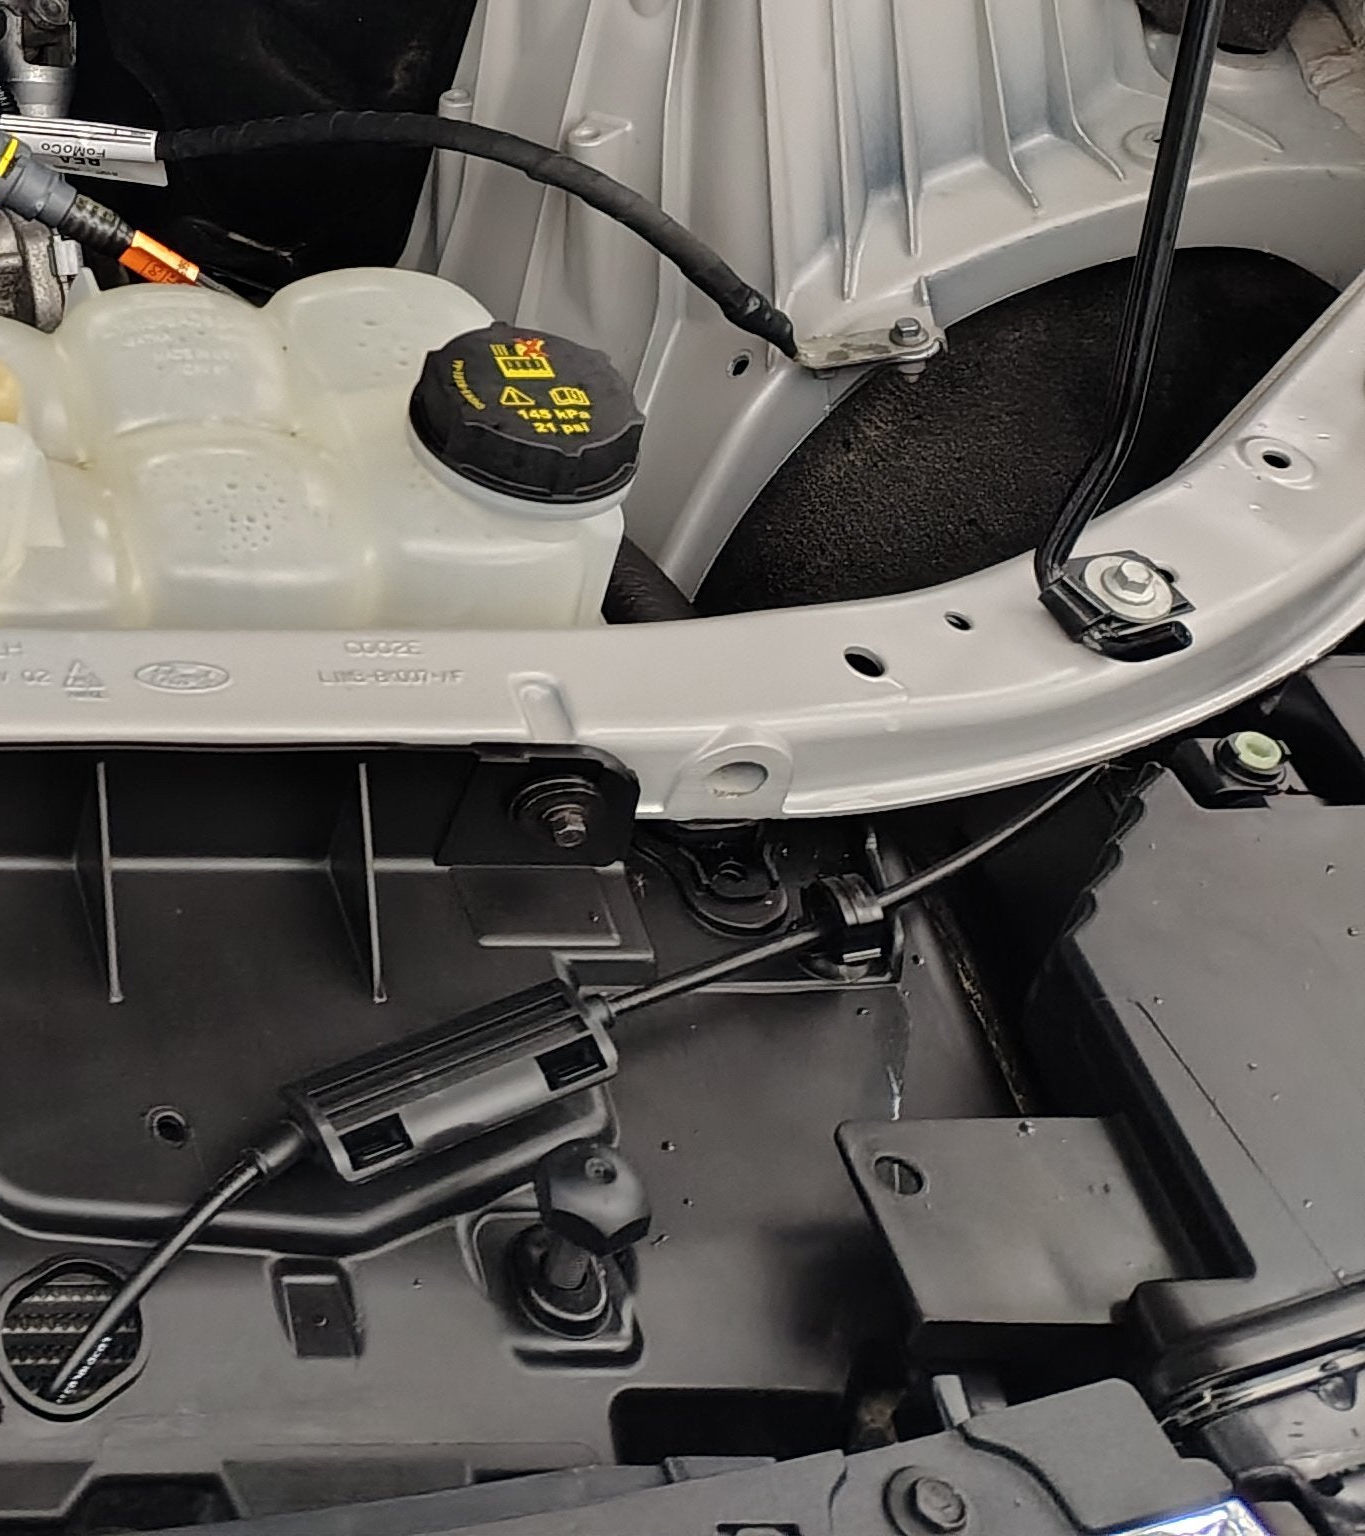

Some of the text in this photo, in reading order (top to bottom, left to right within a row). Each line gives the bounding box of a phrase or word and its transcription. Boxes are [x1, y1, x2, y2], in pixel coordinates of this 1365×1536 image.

[41, 143, 106, 158] FoMoCo
[517, 409, 591, 419] 145 kPa
[532, 422, 590, 435] 21 psi
